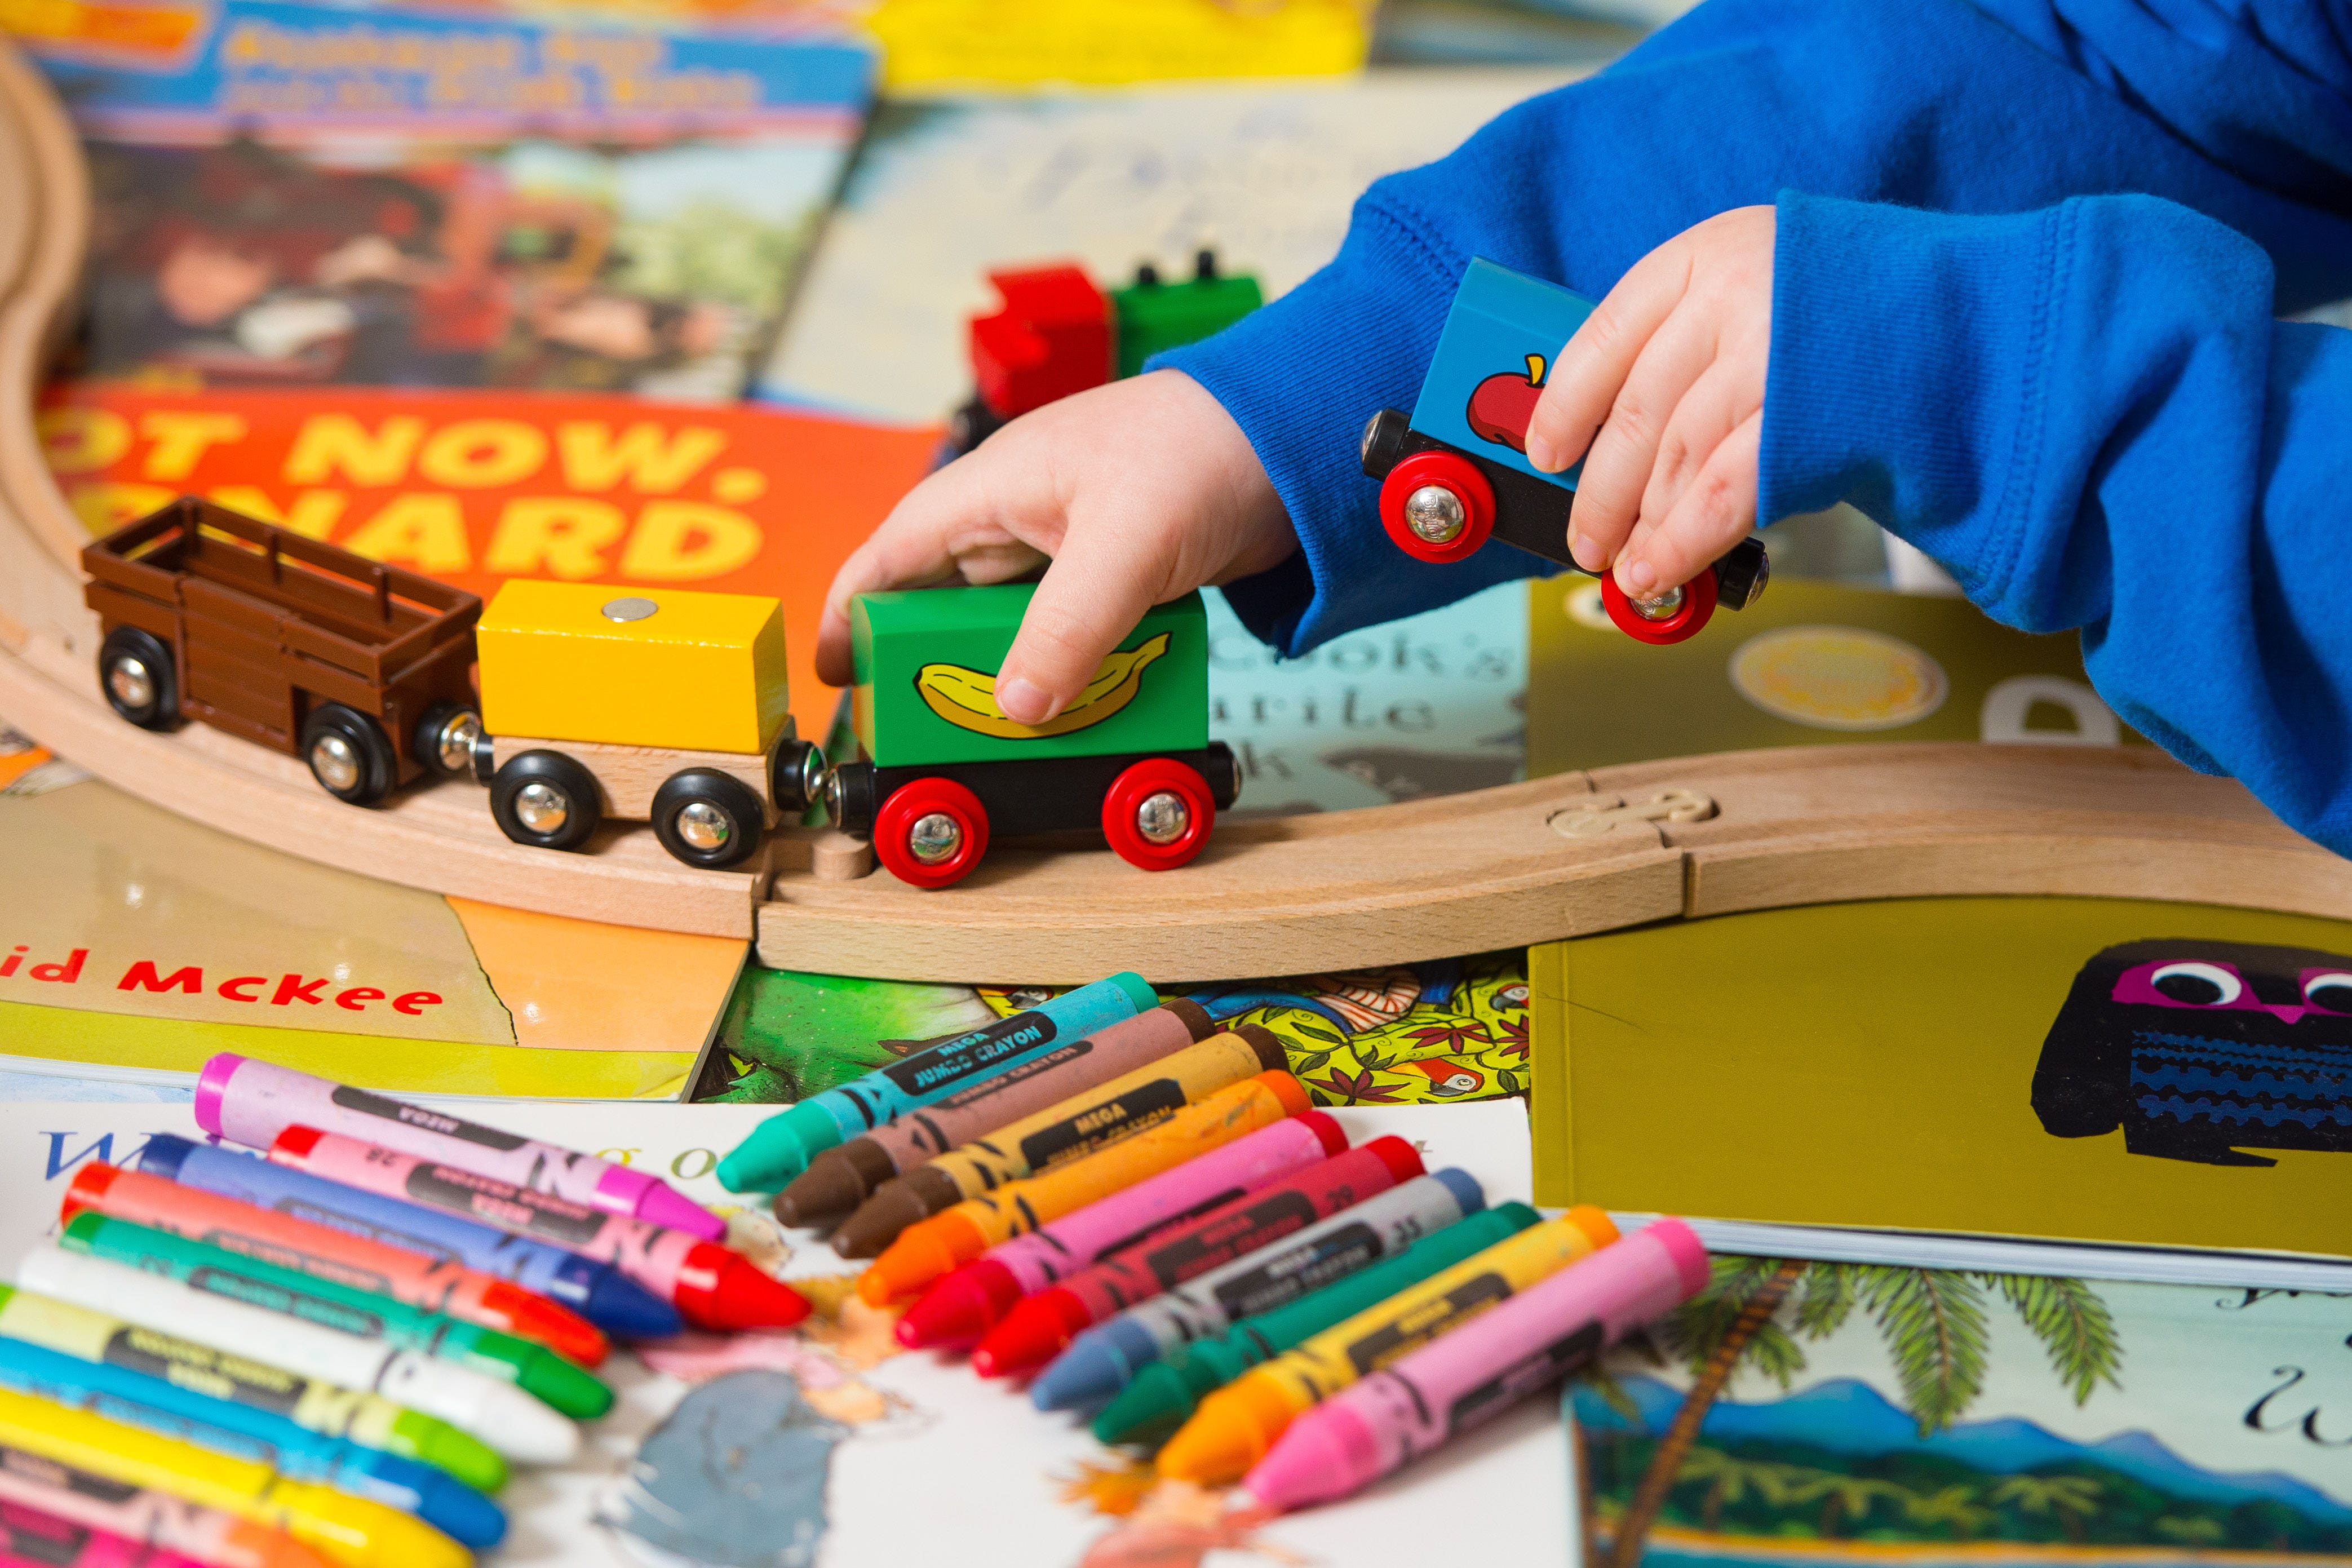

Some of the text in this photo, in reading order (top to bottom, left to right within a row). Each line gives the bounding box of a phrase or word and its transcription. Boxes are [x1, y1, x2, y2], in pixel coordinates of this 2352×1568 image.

[281, 413, 768, 504] NOW.
[0, 945, 443, 1016] id McKee
[914, 1025, 1043, 1088] JUMBO CRAYON
[940, 1031, 990, 1057] MEGA
[1075, 1102, 1127, 1133] MEGA
